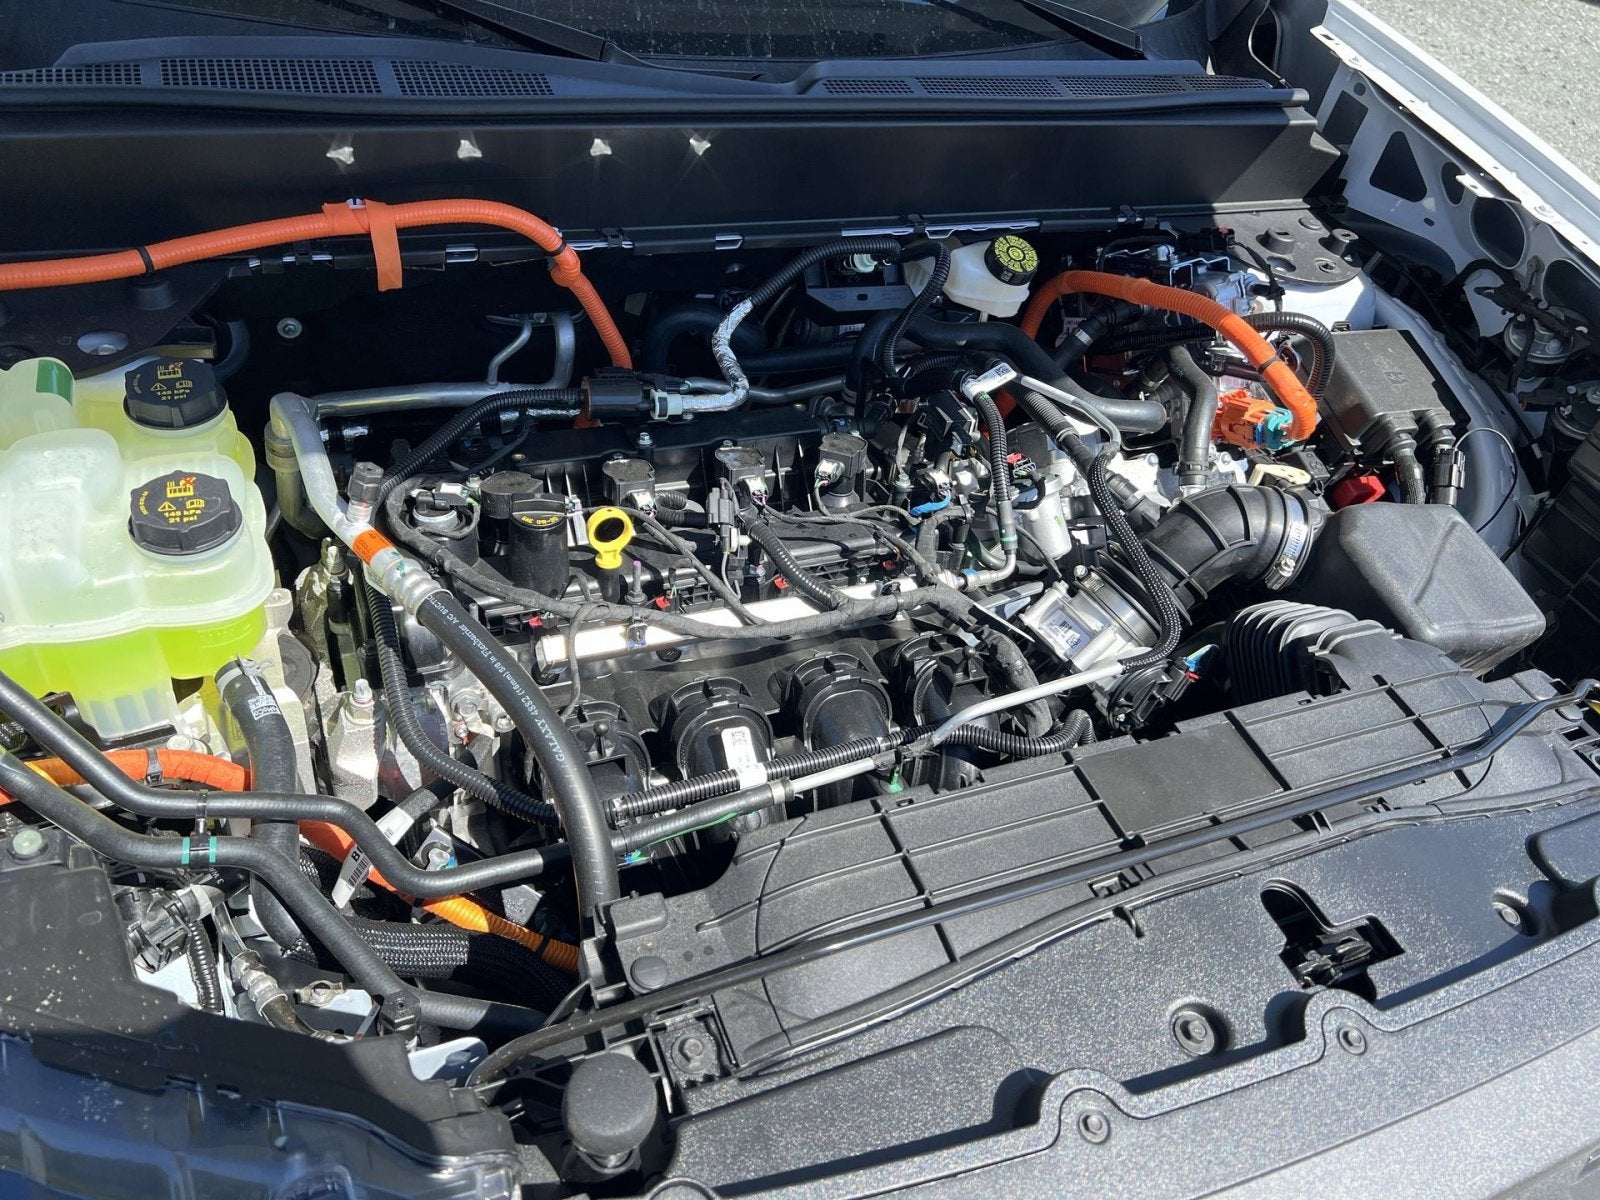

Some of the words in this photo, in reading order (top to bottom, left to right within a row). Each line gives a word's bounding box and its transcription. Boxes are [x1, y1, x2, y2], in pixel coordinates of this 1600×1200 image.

[446, 613, 459, 624] A/C
[459, 624, 493, 658] Flexbarrier
[521, 695, 539, 716] 4882
[535, 718, 565, 762] GALAXY
